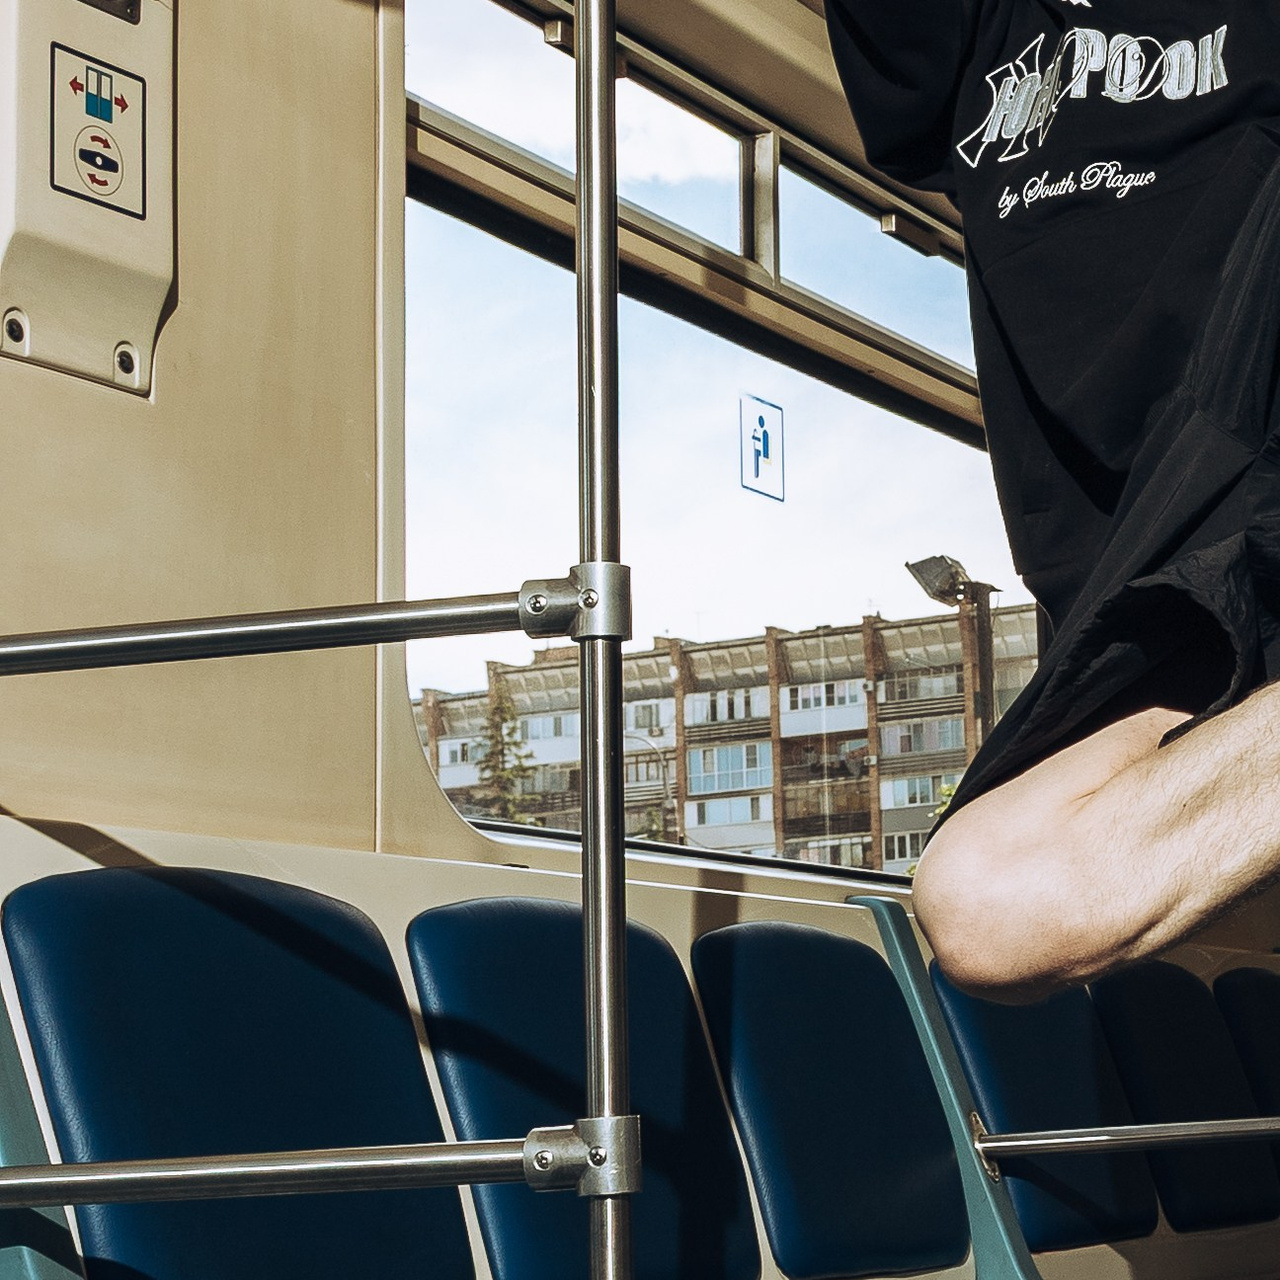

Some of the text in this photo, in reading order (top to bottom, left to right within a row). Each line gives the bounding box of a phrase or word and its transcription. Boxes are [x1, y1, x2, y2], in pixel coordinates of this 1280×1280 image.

[997, 160, 1157, 220] by South Plague
